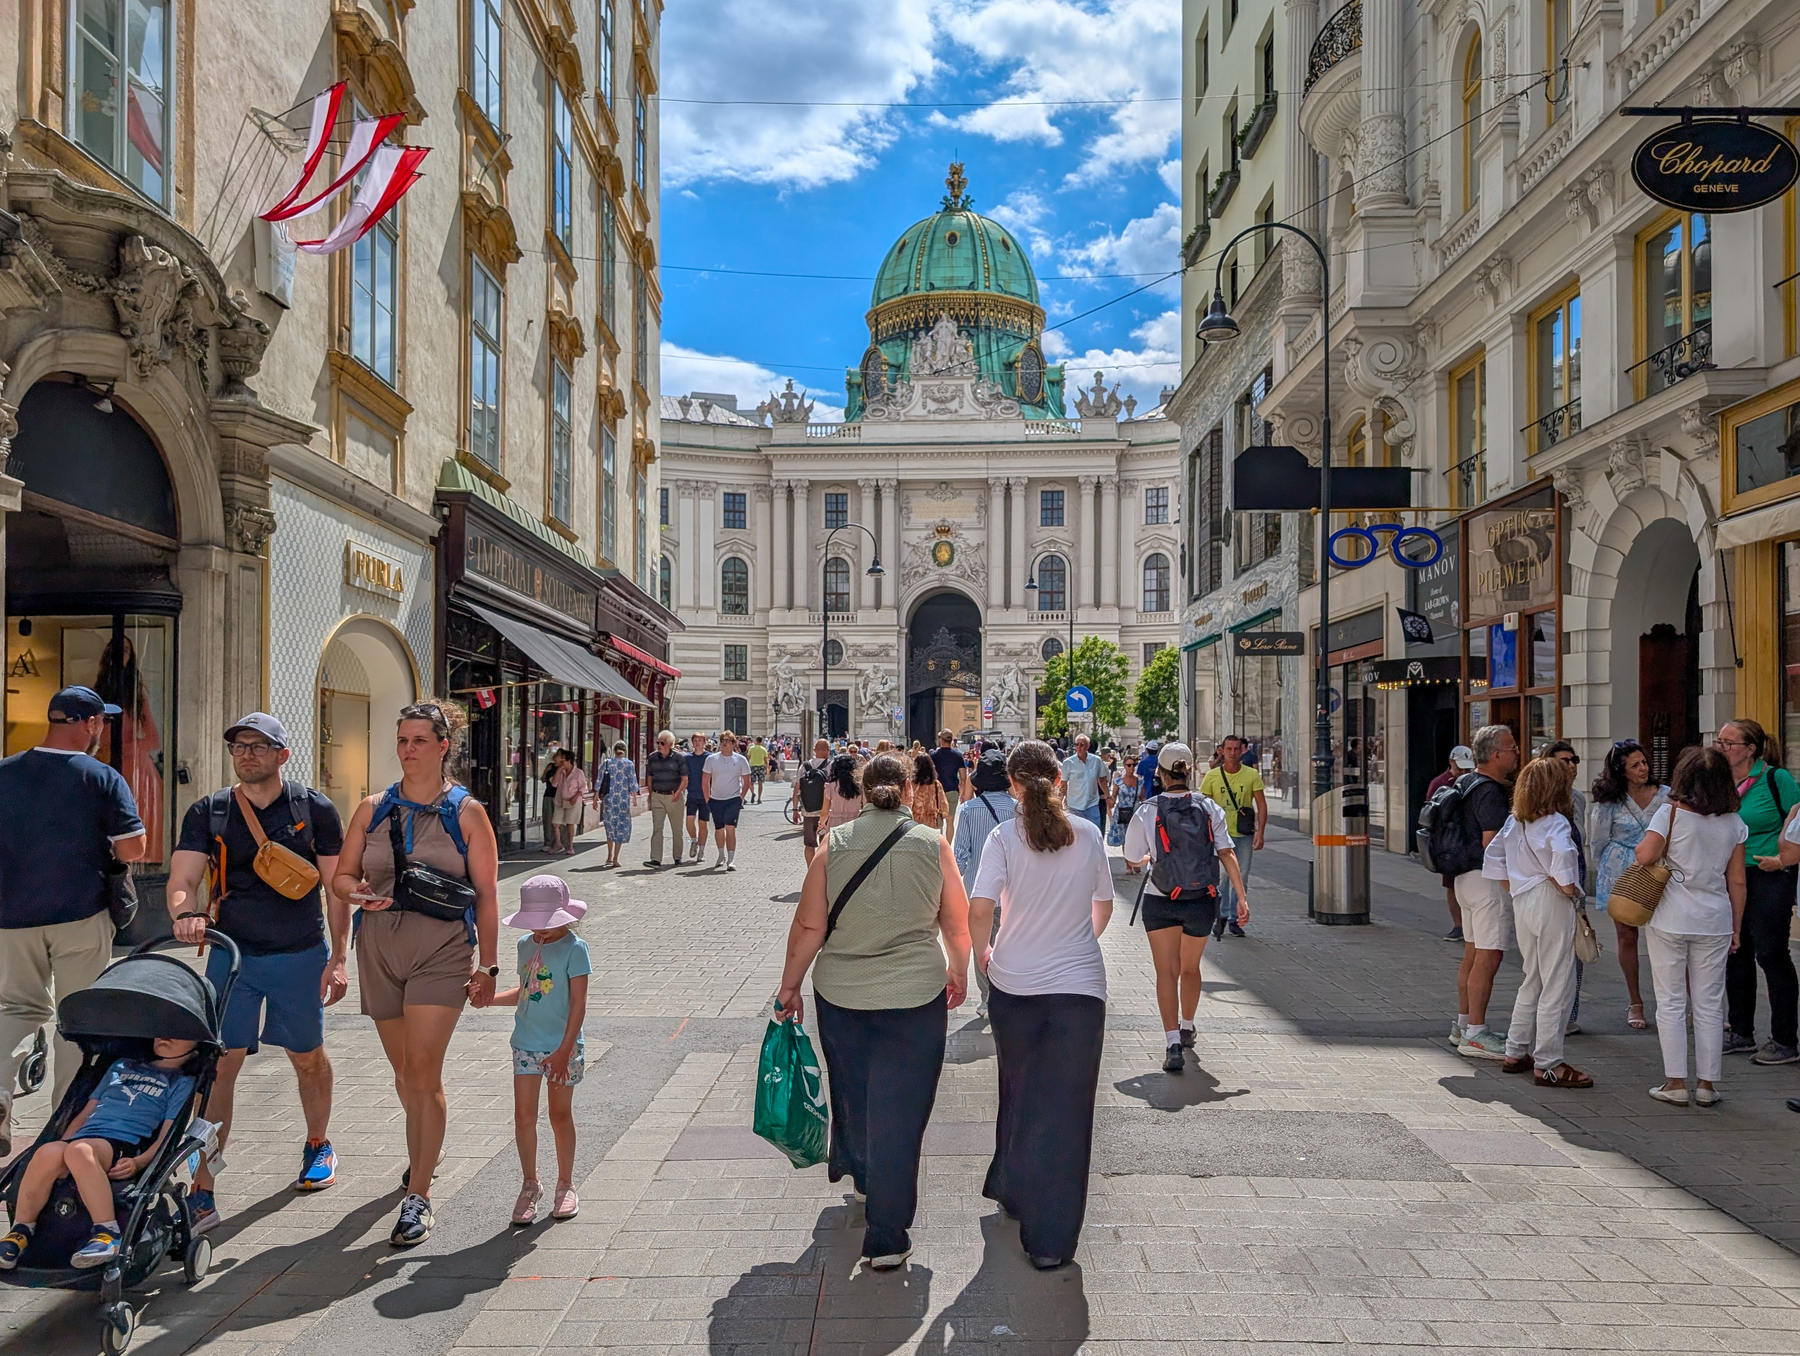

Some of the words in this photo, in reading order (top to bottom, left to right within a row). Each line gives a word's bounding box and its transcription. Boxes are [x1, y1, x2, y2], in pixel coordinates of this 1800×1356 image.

[1651, 141, 1781, 181] Chopard
[1693, 182, 1739, 193] GENÈVE
[1486, 509, 1531, 549] OPTIK
[354, 549, 404, 593] FURLA
[476, 536, 532, 595] IMPERIAL
[543, 574, 592, 623] SOUVENIRS
[1418, 555, 1456, 585] MANOV
[1477, 553, 1545, 596] PILLWEIN
[1251, 637, 1274, 650] Loro
